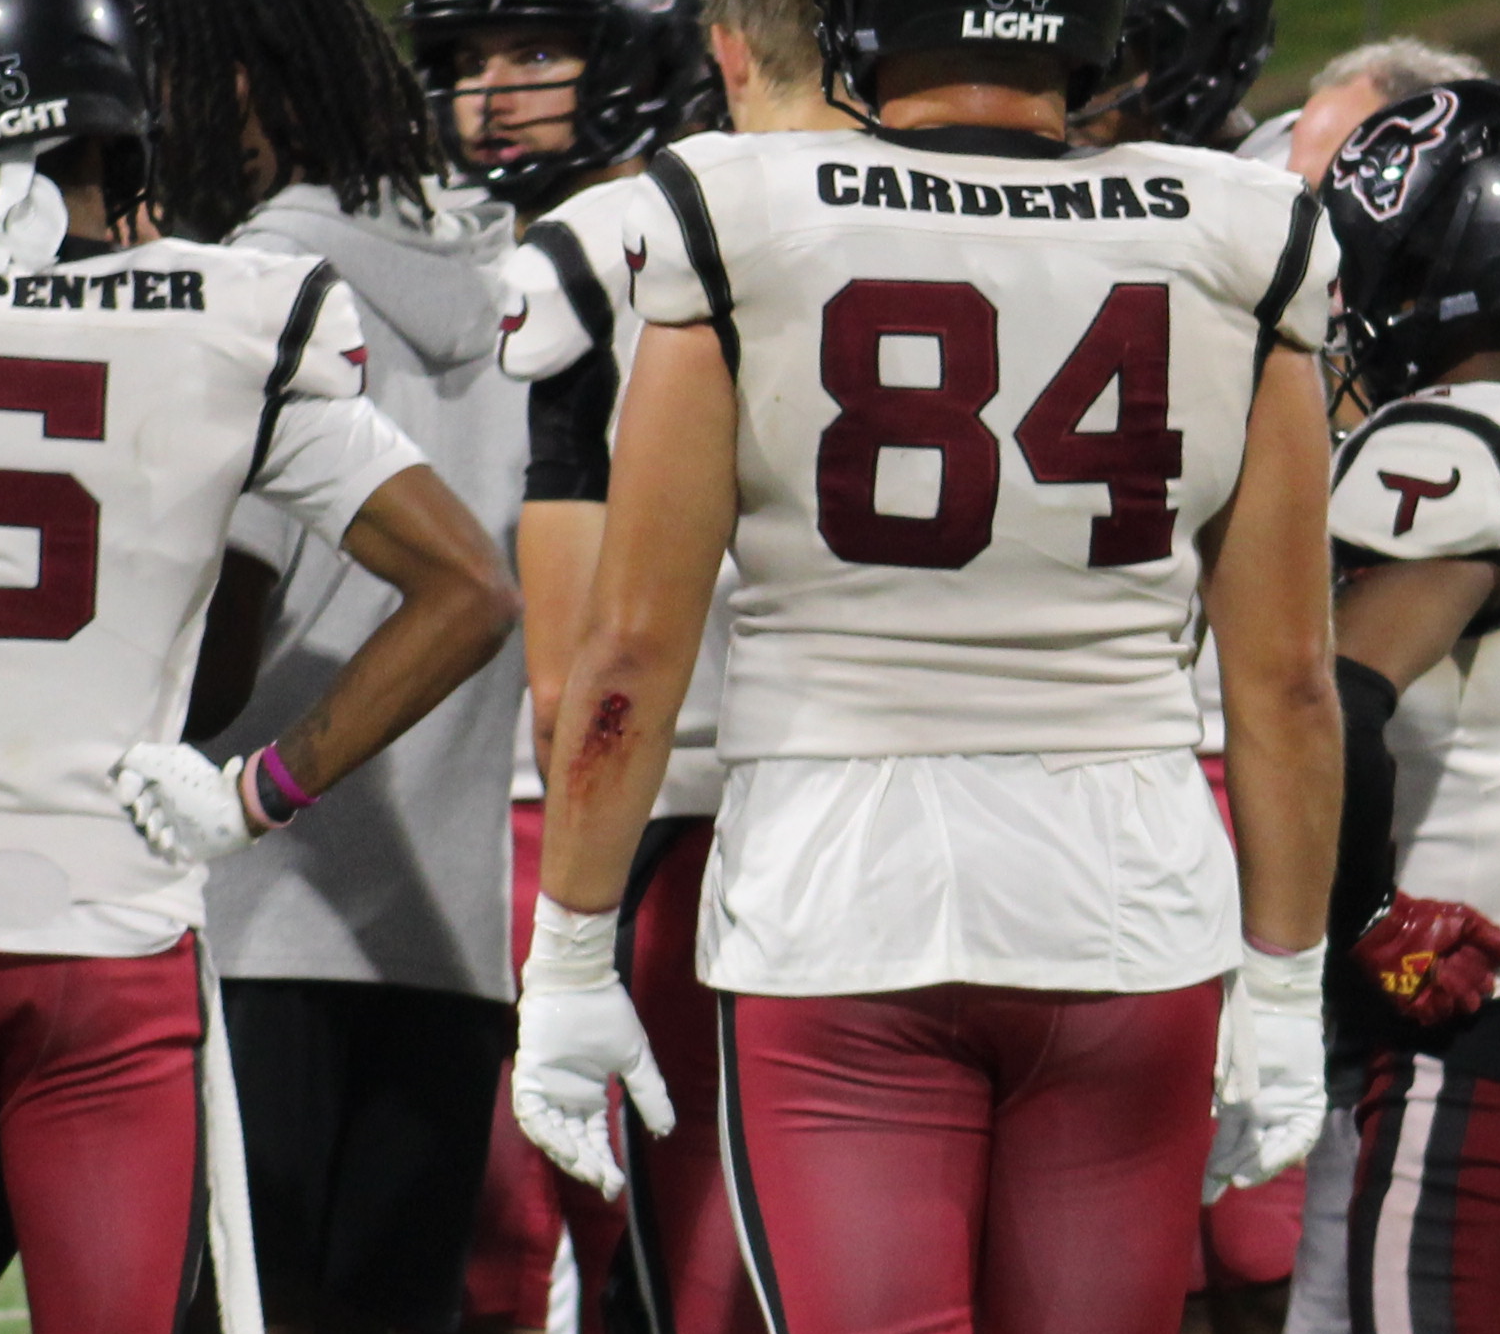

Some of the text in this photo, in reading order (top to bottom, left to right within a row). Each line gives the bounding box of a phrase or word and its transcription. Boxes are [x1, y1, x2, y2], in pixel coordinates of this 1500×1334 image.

[962, 10, 1064, 43] LIGHT
[816, 160, 1191, 219] CARDENAS
[815, 278, 1184, 570] 84
